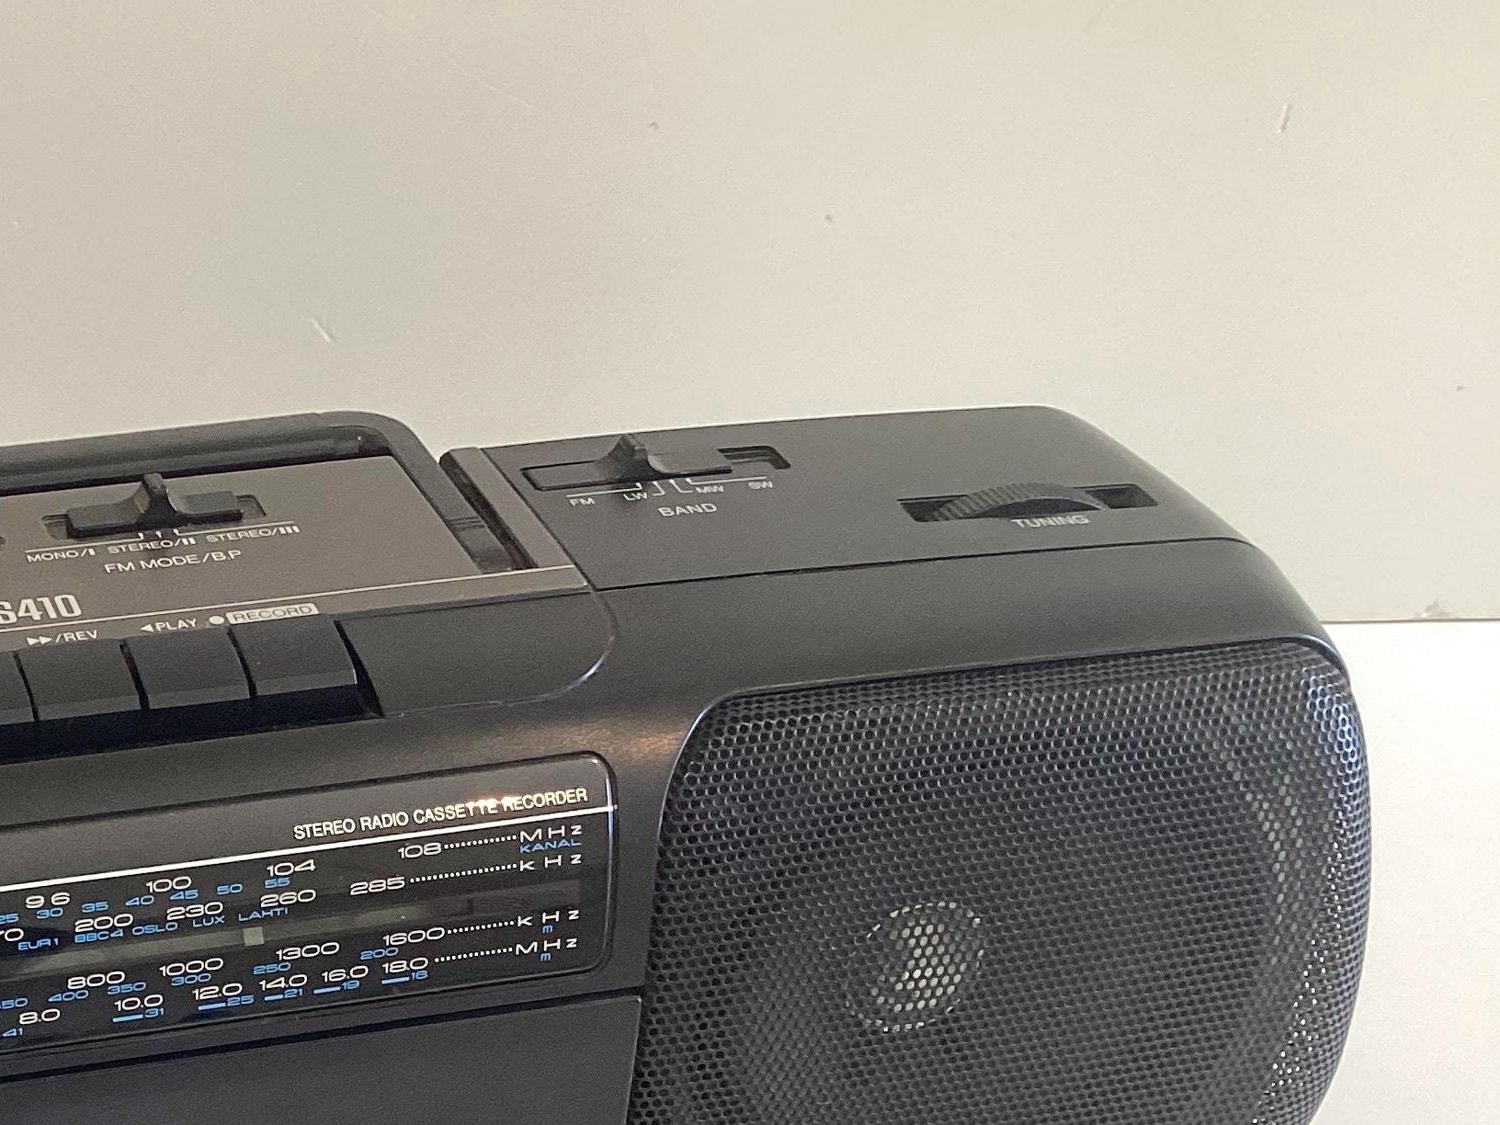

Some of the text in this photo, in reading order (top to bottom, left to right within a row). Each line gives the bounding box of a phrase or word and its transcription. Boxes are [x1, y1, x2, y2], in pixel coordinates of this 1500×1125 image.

[570, 479, 774, 508] FM LW MW SW
[658, 502, 717, 518] BAND
[1011, 514, 1092, 529] TUNING
[104, 561, 136, 575] FM
[155, 617, 198, 633] PLAY
[232, 604, 313, 623] RECORD
[293, 787, 588, 841] STEREO RADIO CASSETTE RECORDER
[36, 908, 64, 919] 30
[82, 901, 109, 913] 35
[125, 895, 155, 907] 40
[170, 889, 199, 901] 45
[217, 883, 243, 896] 50
[264, 877, 291, 889] 55
[520, 839, 582, 854] KANAL
[146, 876, 192, 894] 100
[266, 859, 316, 878] 104
[398, 842, 443, 859] 108
[74, 913, 134, 932] 200
[166, 901, 223, 921] 230
[260, 889, 316, 908] 260
[350, 877, 406, 896] 285
[131, 922, 178, 936] OSLO
[193, 914, 225, 928] LUX
[238, 907, 289, 922] LAHTI
[48, 989, 89, 1003] 400
[107, 981, 147, 995] 350
[171, 972, 212, 987] 300
[252, 961, 292, 975] 250
[360, 946, 399, 961] 200
[67, 970, 126, 990] 800
[159, 957, 224, 977] 1000
[276, 941, 340, 961] 1300
[383, 926, 446, 946] 1600
[2, 1027, 24, 1039] 41
[145, 1007, 164, 1018] 31
[227, 994, 254, 1007] 25
[283, 988, 303, 1000] 21
[410, 970, 429, 981] 16
[18, 1008, 61, 1025] 8.0
[114, 994, 164, 1012] 10.0
[192, 983, 243, 1001] 12.0
[258, 974, 308, 991] 14.0
[321, 965, 369, 983] 16.0
[382, 956, 429, 974] 18.0
